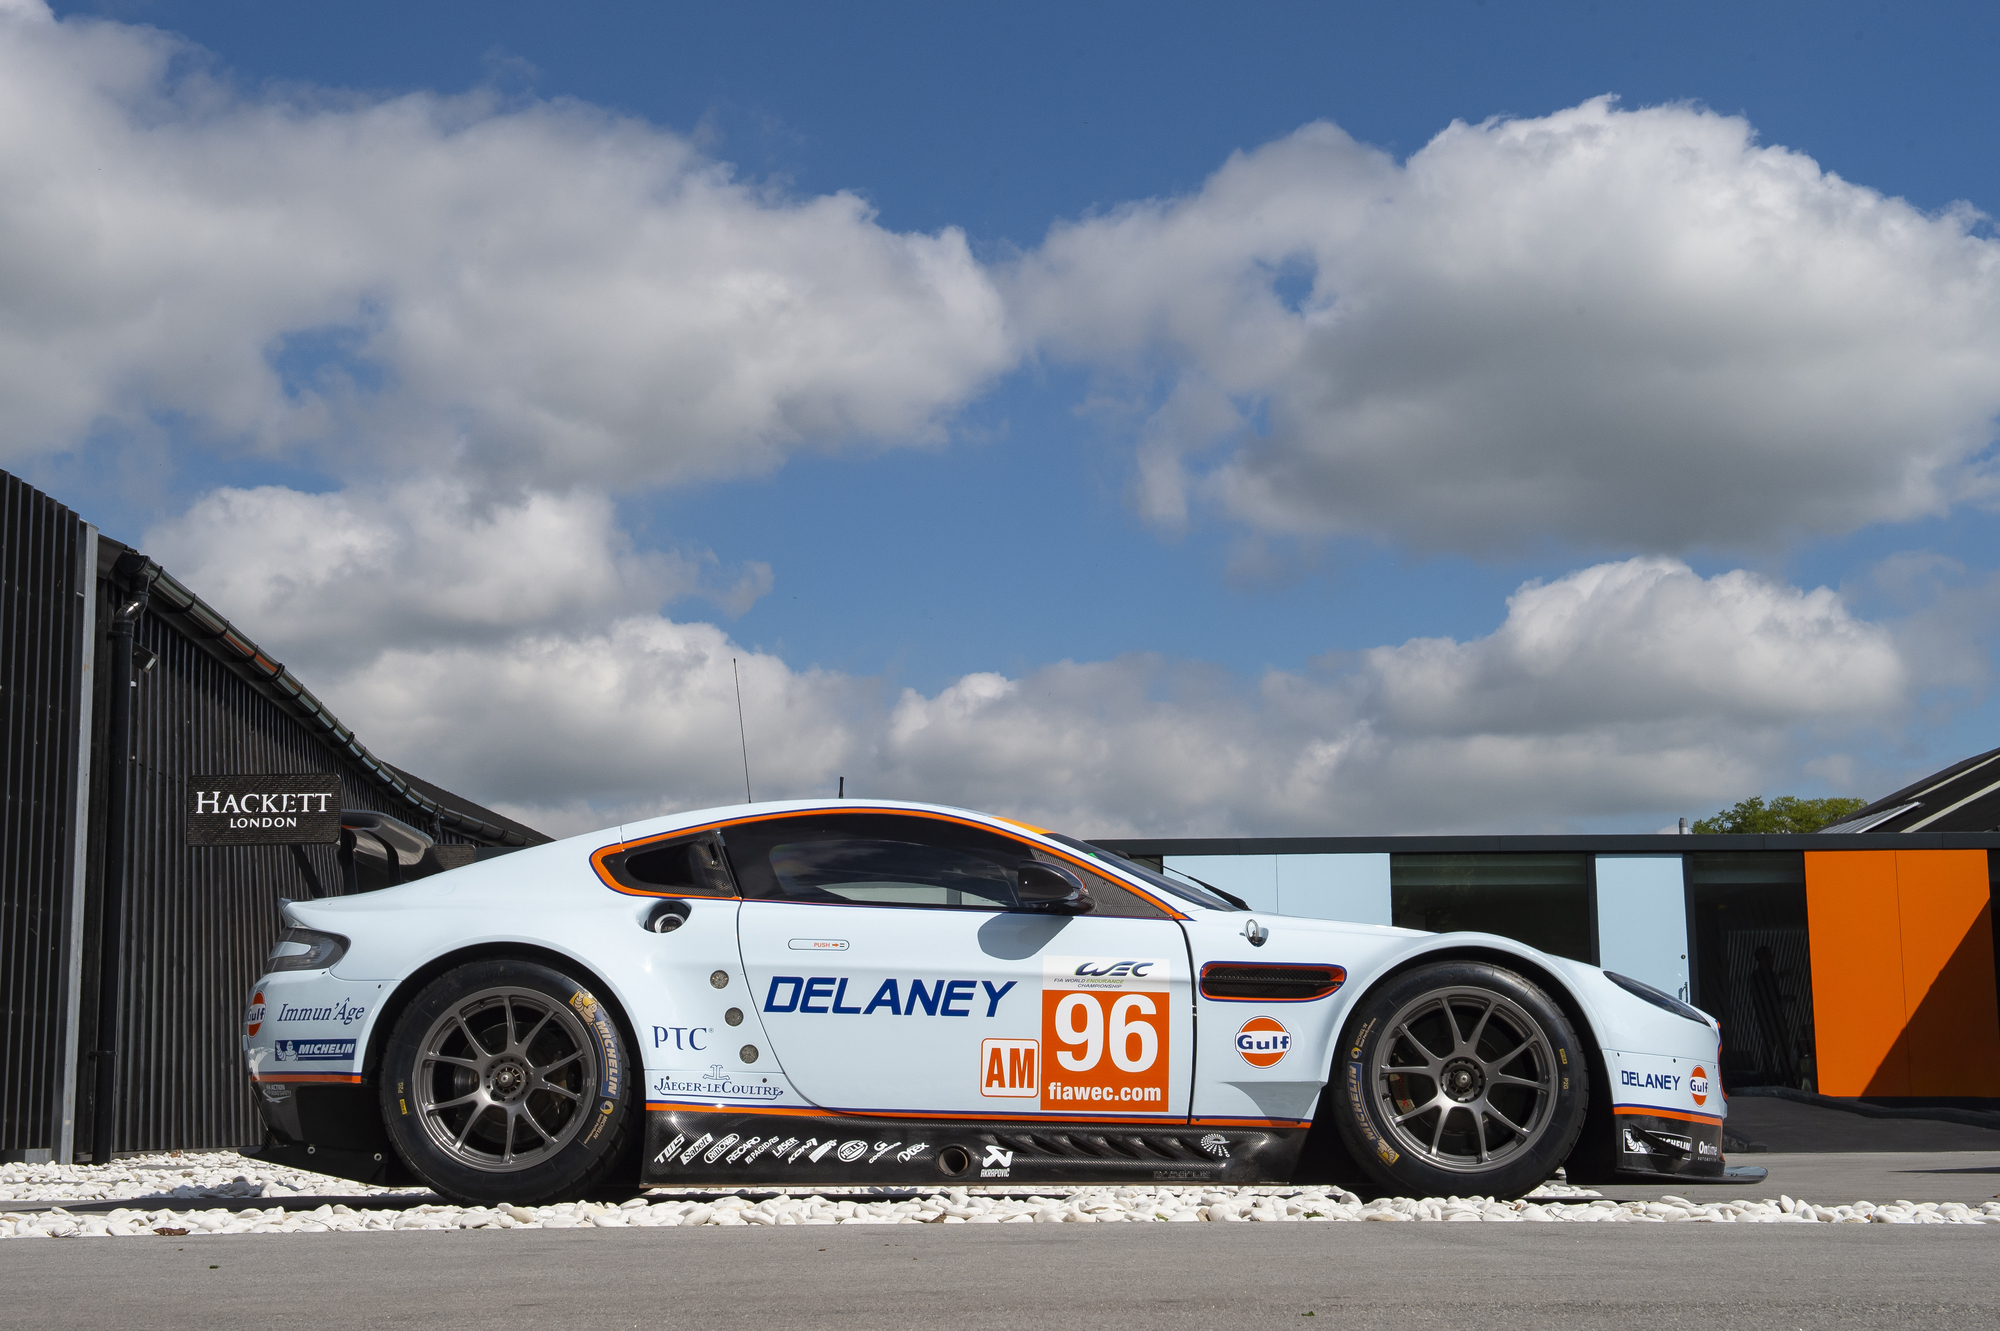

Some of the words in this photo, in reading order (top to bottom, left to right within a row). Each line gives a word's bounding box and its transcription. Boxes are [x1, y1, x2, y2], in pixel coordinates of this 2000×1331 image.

[196, 791, 332, 814] HACKETT
[230, 817, 297, 829] LONDON
[1074, 960, 1154, 977] WEC
[763, 976, 1018, 1018] DELANEY
[1054, 992, 1159, 1073] 96
[1236, 1034, 1290, 1051] Gulf
[298, 1043, 355, 1055] MICHELIN
[595, 1020, 617, 1096] MICHELIN
[985, 1047, 1036, 1089] AM
[1621, 1070, 1681, 1091] DELANEY
[1690, 1079, 1709, 1094] Gulf
[1048, 1082, 1162, 1102] fiawec.com
[1349, 1066, 1376, 1141] MICHELIN
[684, 1137, 710, 1161] Sabelt
[708, 1135, 736, 1161] RIMOWA
[725, 1136, 761, 1165] RECARO
[772, 1136, 798, 1157] LASER
[840, 1141, 868, 1159] HELLA
[1698, 1140, 1718, 1156] Ontime
